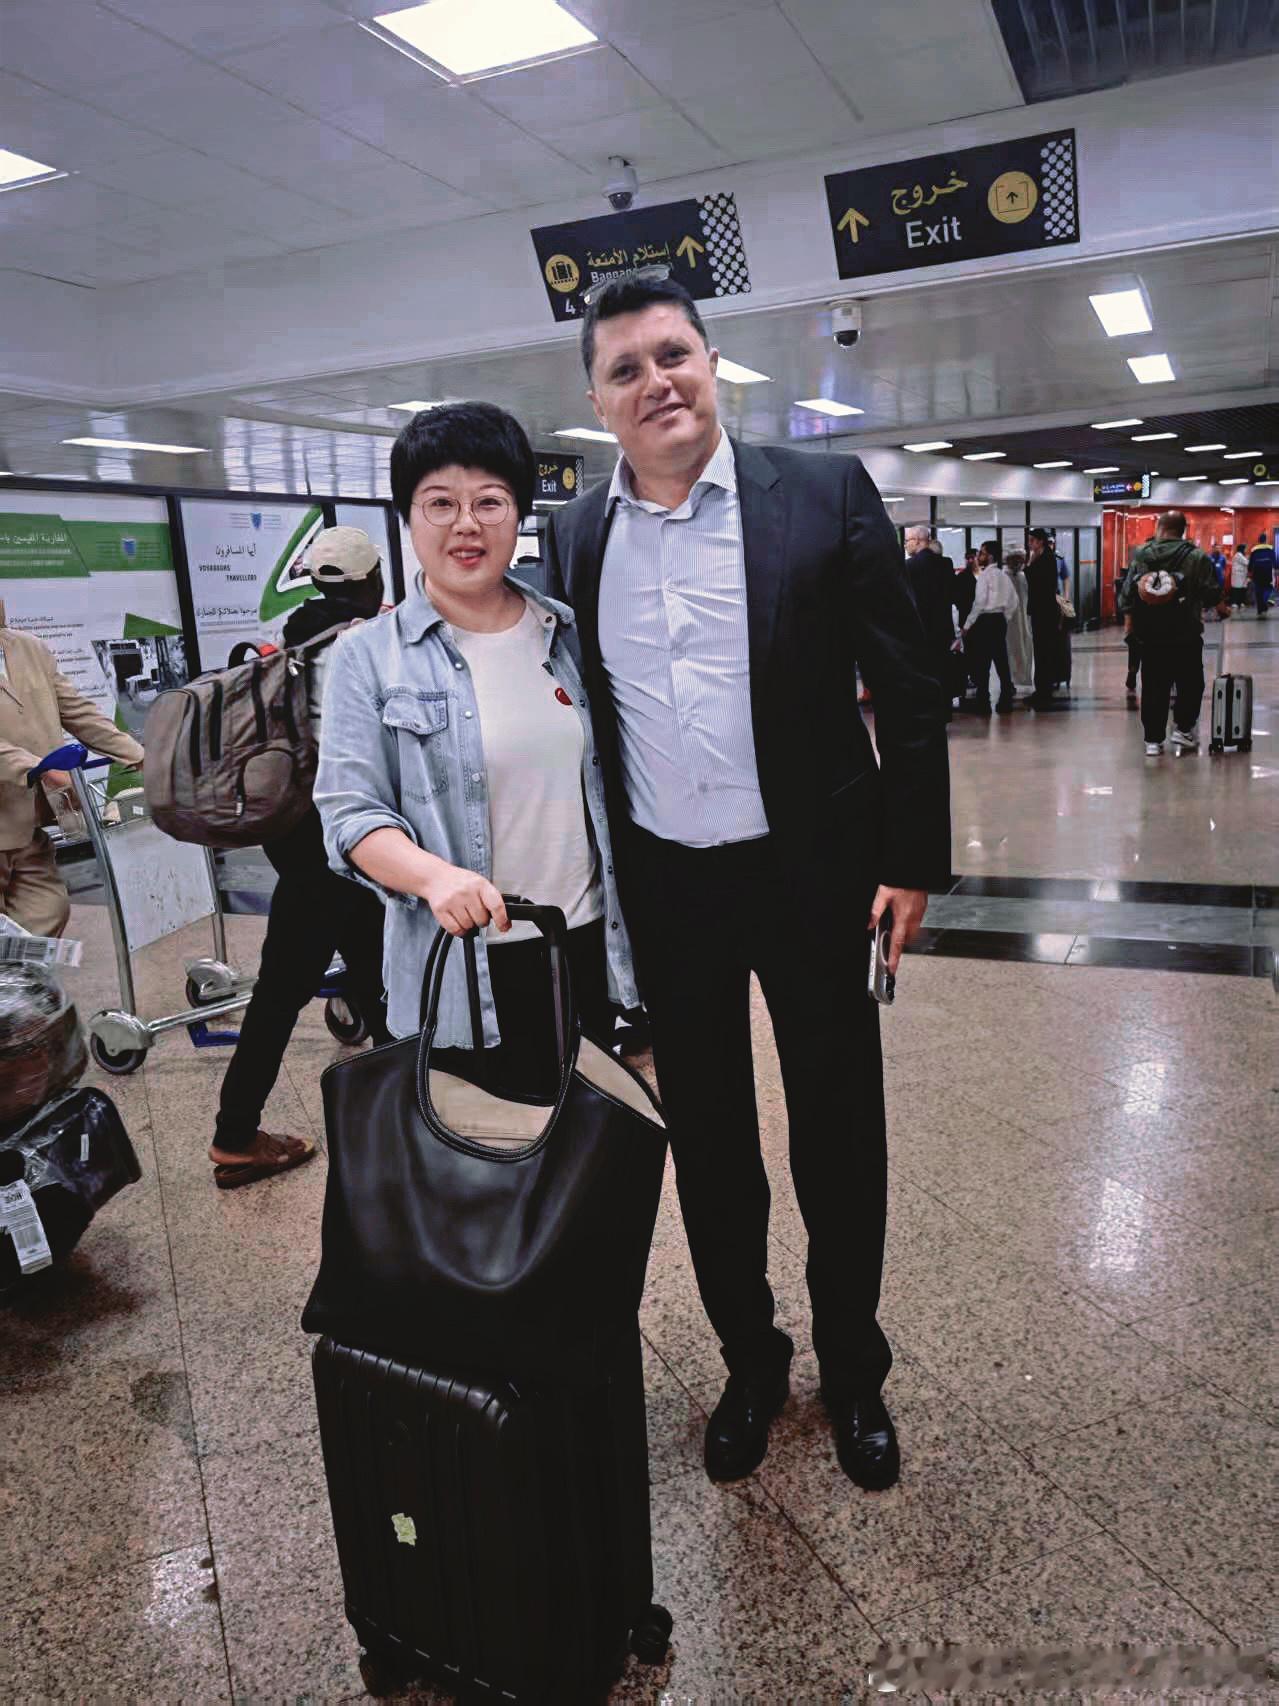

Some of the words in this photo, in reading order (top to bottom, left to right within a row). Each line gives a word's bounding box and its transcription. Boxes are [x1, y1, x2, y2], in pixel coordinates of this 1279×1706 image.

[891, 169, 969, 215] خروج
[905, 215, 963, 249] Exit
[542, 479, 557, 492] Exit
